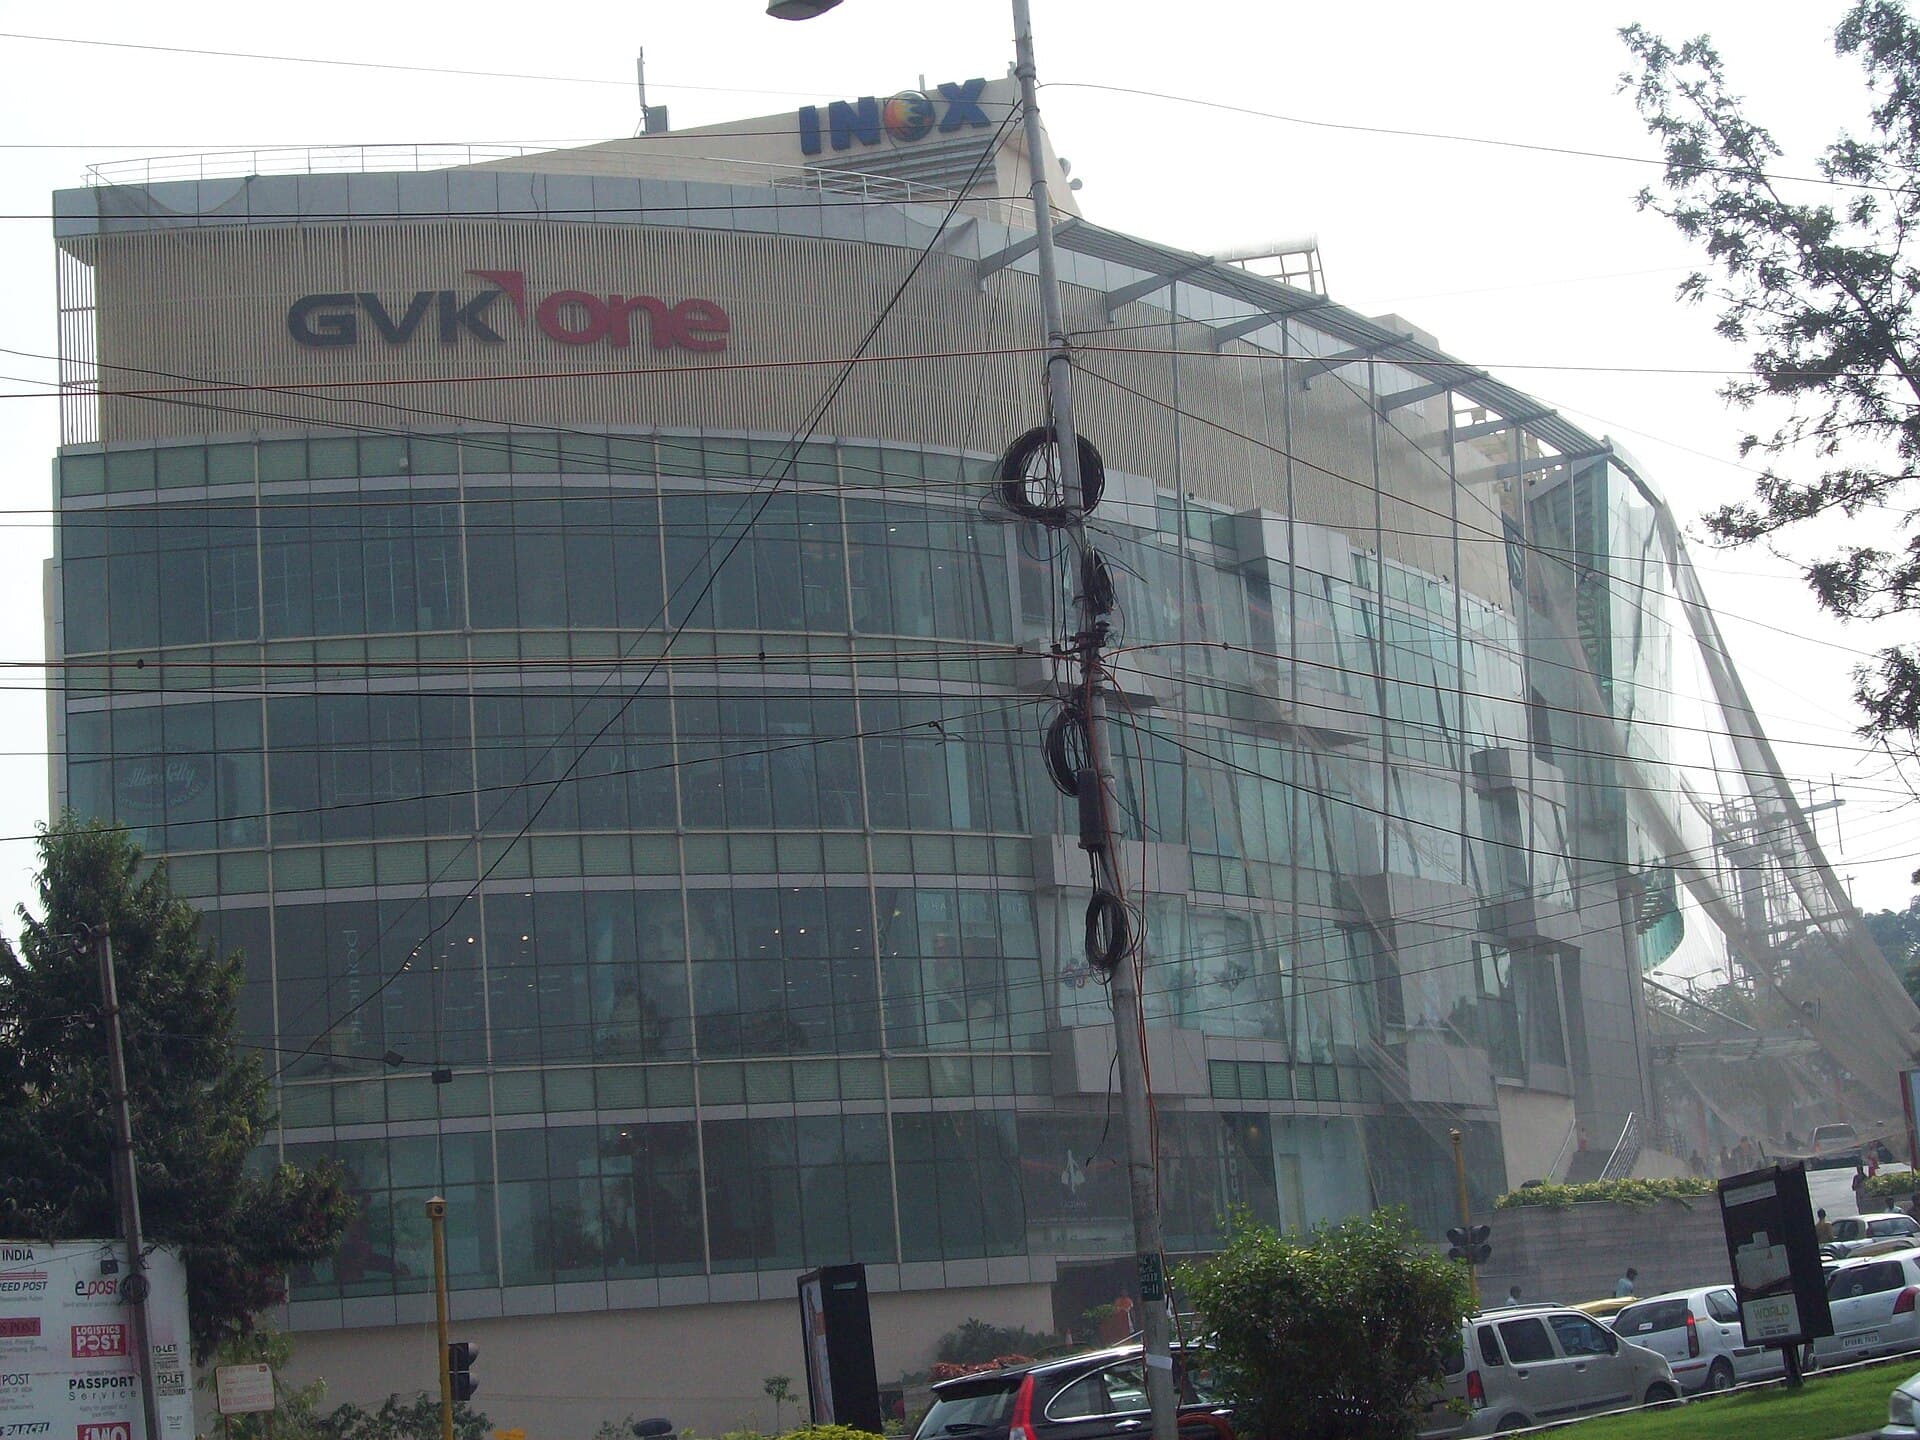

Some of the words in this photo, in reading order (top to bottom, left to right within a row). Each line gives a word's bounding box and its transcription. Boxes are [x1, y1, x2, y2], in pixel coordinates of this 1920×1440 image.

[799, 77, 991, 155] INOX
[287, 289, 505, 347] GVK
[535, 289, 730, 353] one
[2, 1249, 34, 1261] INDIA
[22, 1280, 48, 1291] POST
[76, 1326, 120, 1335] LOGISTICS
[76, 1334, 121, 1351] POST
[2, 1373, 30, 1386] POST
[69, 1376, 134, 1390] PASSPORT
[157, 1374, 185, 1384] TO-LET
[69, 1390, 137, 1401] Service
